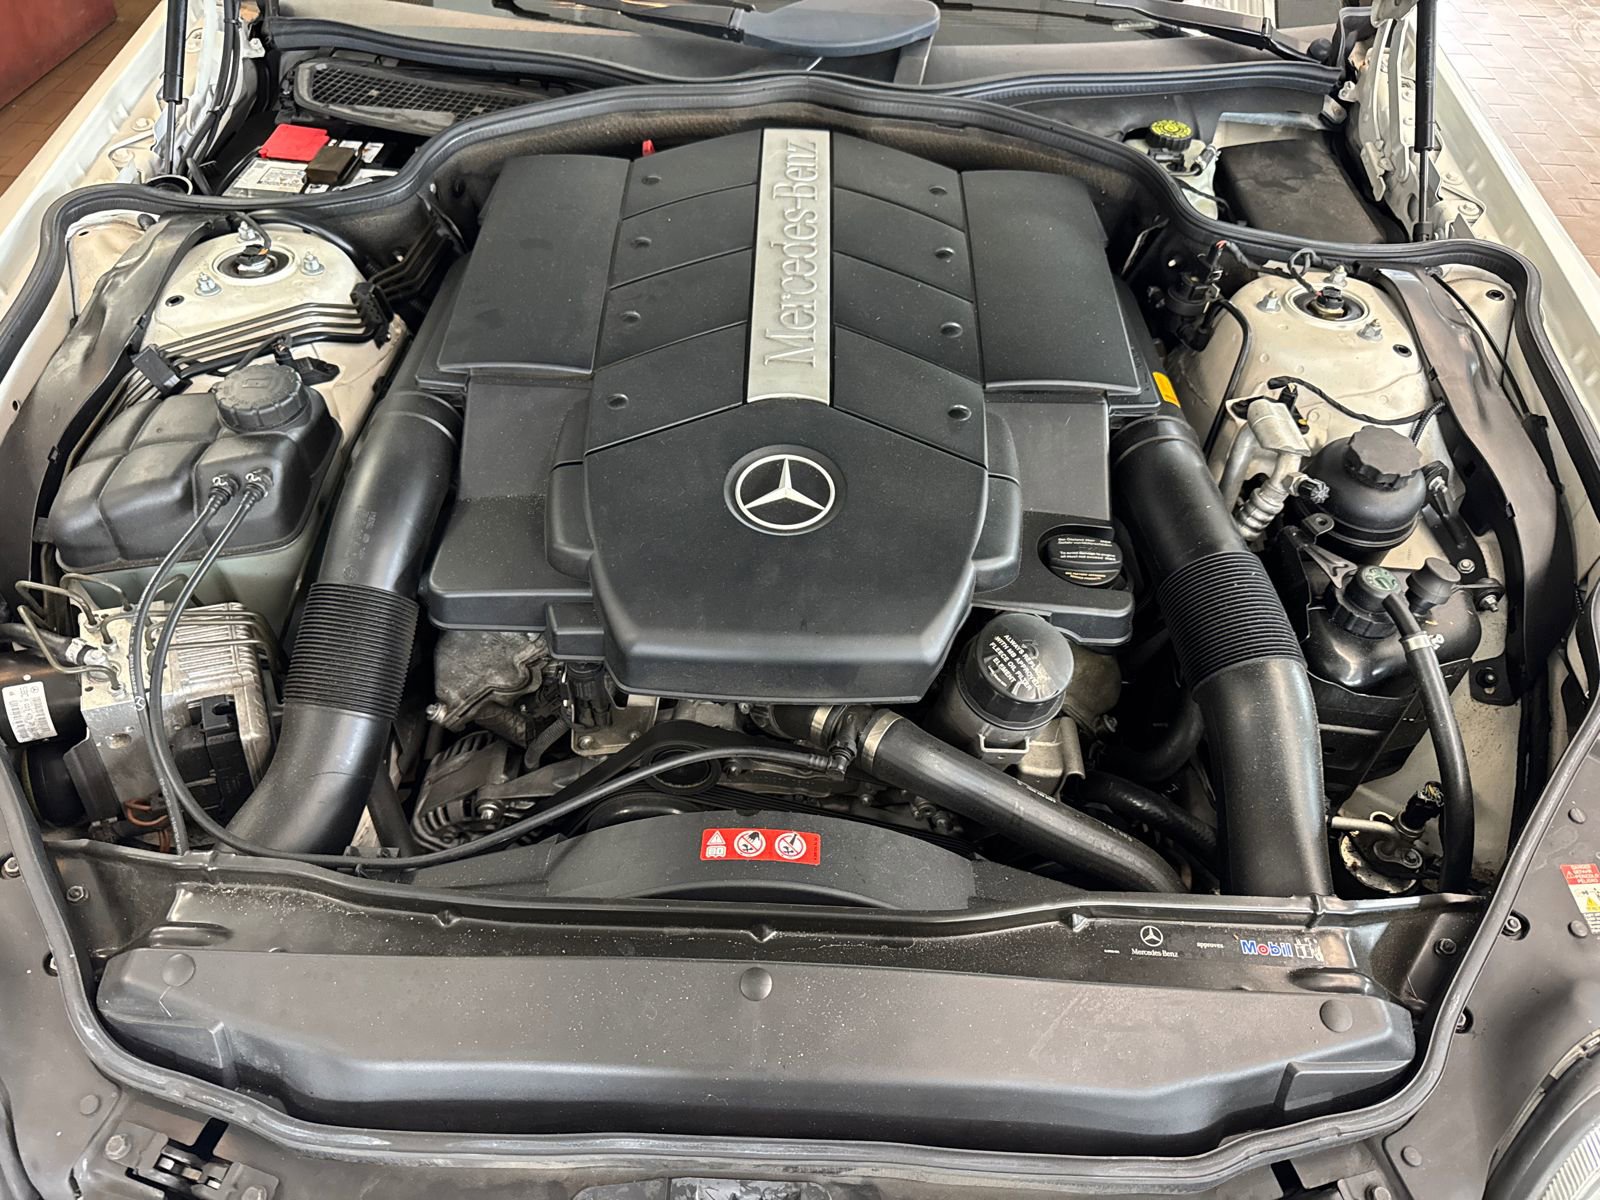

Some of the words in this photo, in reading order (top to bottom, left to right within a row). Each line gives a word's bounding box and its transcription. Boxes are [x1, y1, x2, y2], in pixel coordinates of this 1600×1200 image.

[763, 139, 818, 368] Mercedes-Benz
[994, 636, 1010, 650] WITH
[1003, 634, 1025, 655] ALWAYS
[989, 642, 1010, 663] FLEECE
[1007, 661, 1017, 672] OIL
[1015, 670, 1033, 692] FILTER
[992, 657, 1017, 683] ELEMENT
[1240, 939, 1293, 957] Mobil
